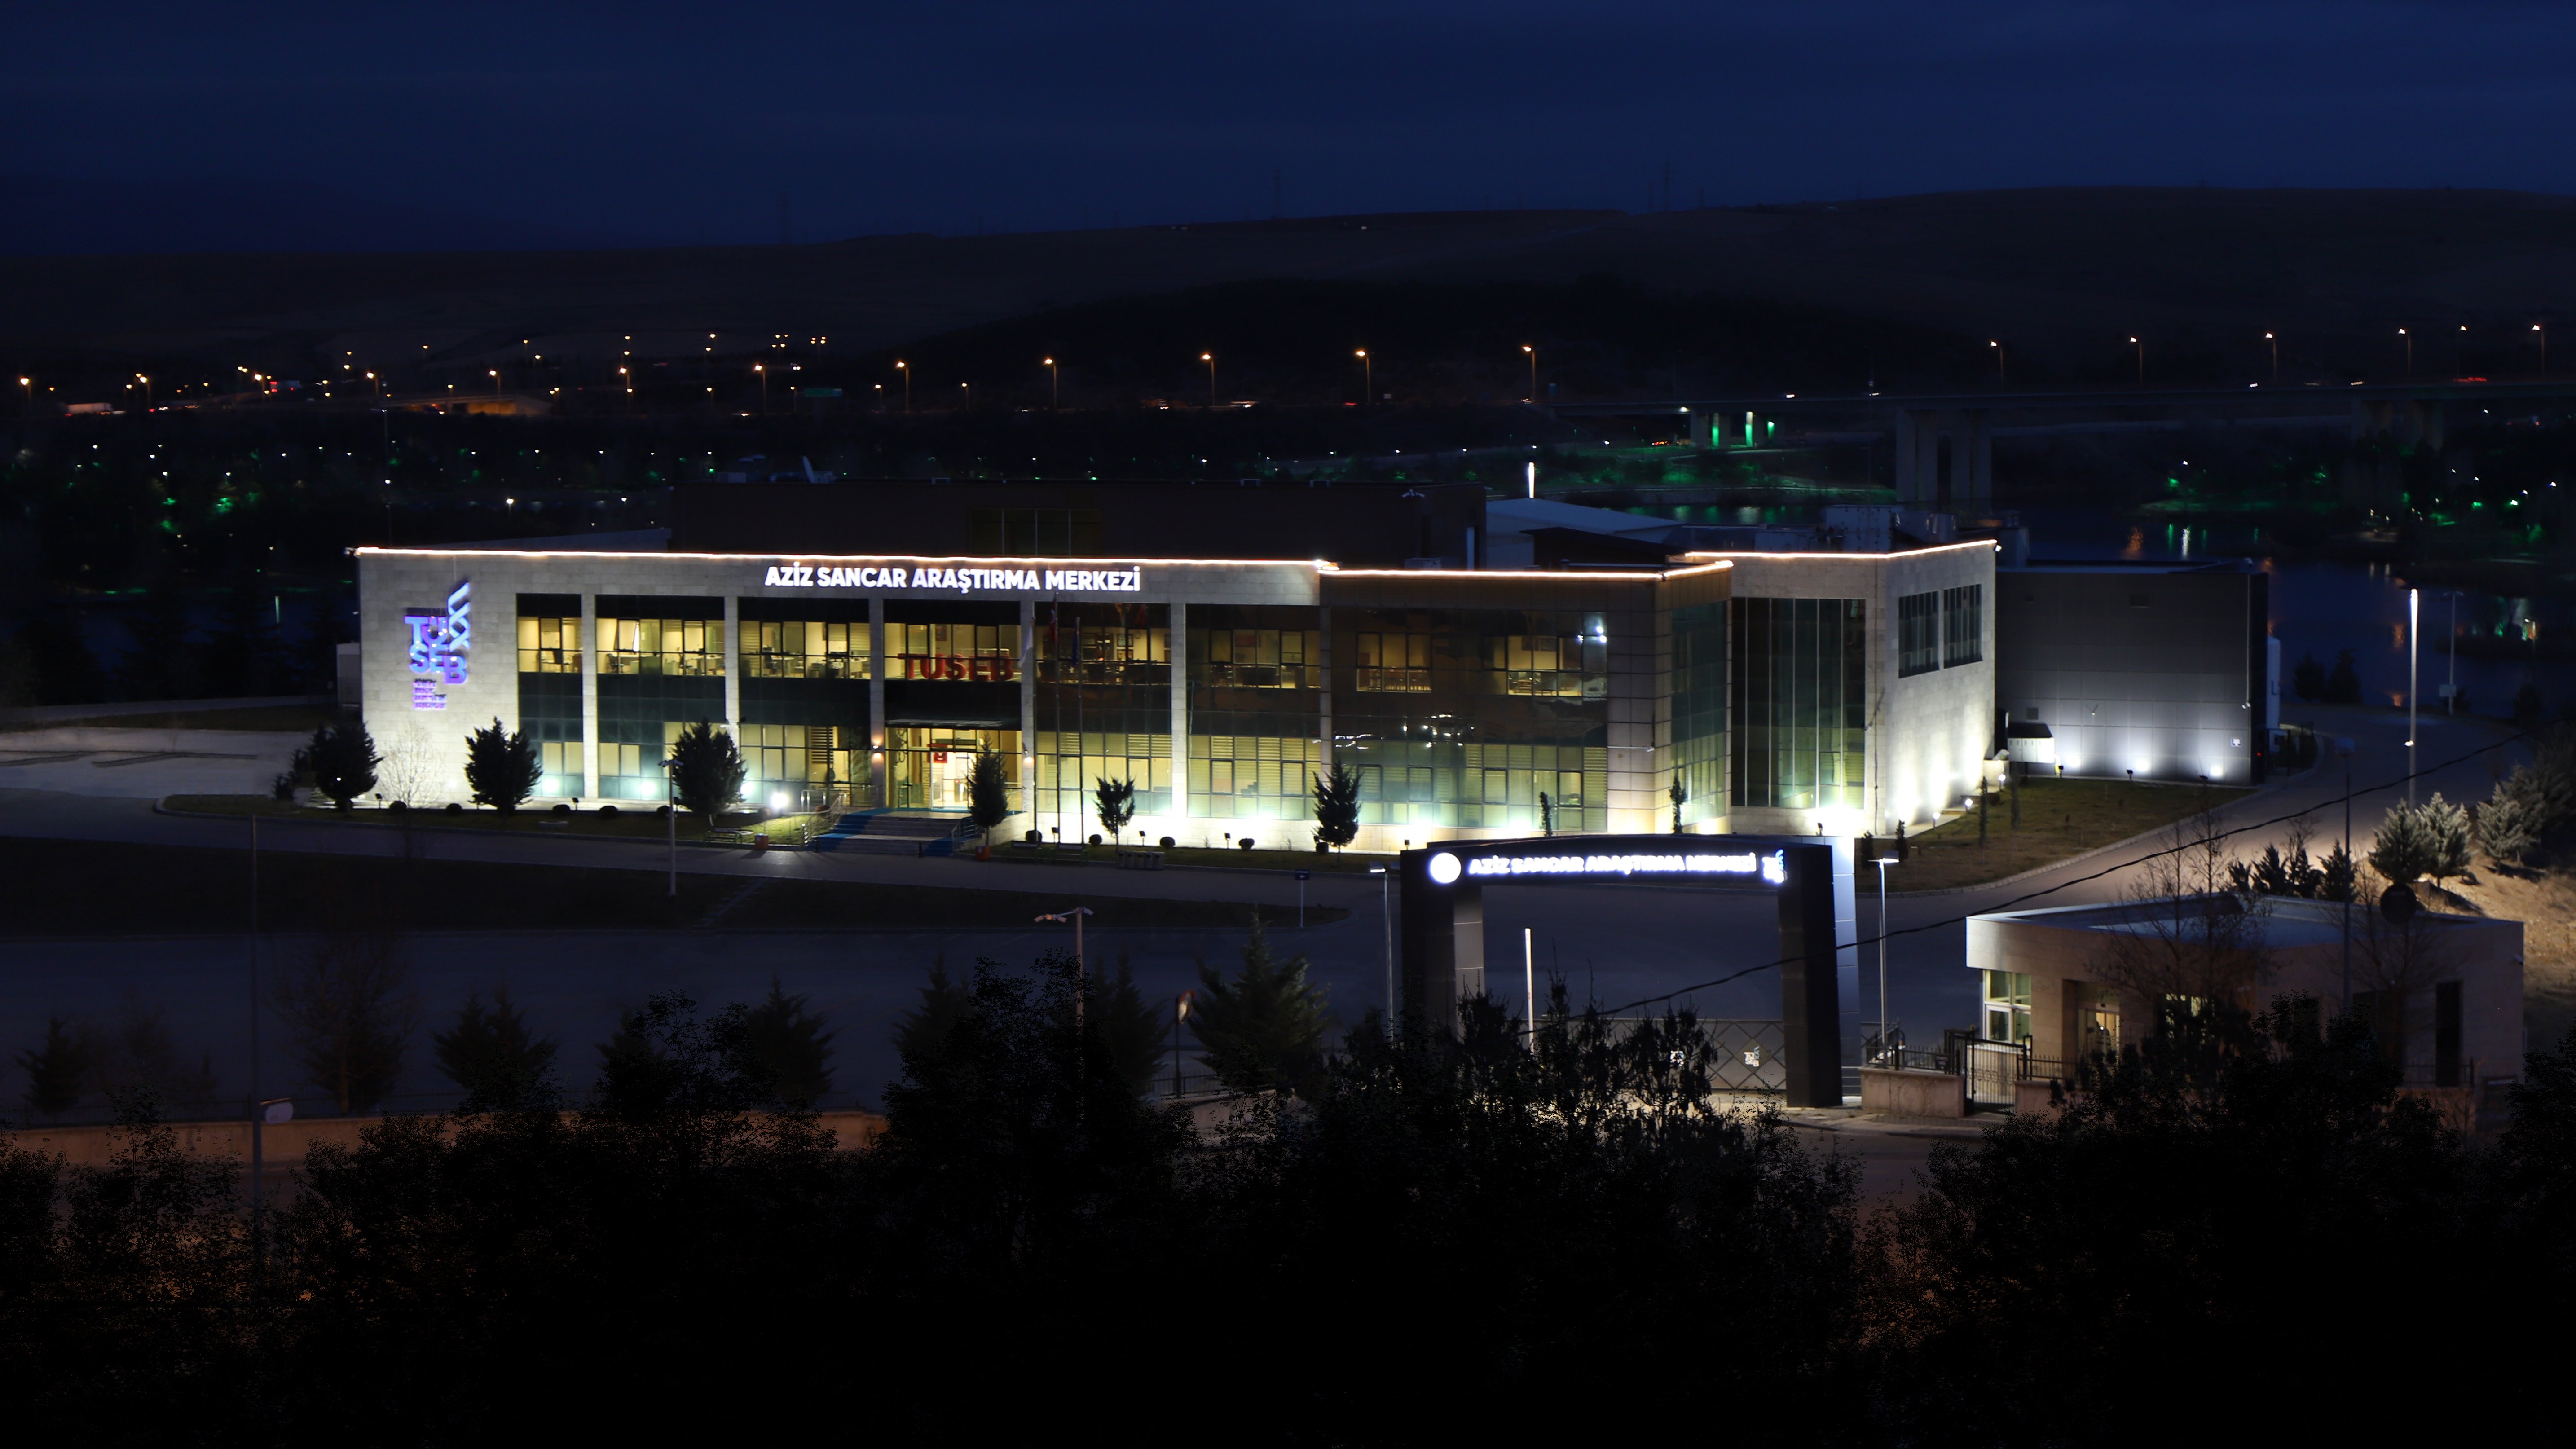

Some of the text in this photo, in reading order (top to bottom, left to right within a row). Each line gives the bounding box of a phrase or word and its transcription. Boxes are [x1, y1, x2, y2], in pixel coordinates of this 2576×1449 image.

[764, 561, 1141, 594] AZİZ SANCAR ARAŞTIRMA MERKEZİ
[1468, 855, 1510, 874] AZİZ
[1511, 856, 1585, 873] SANCAR
[1585, 855, 1686, 875] ARAŞTIRMA
[1686, 852, 1757, 872] MERKEZİ
